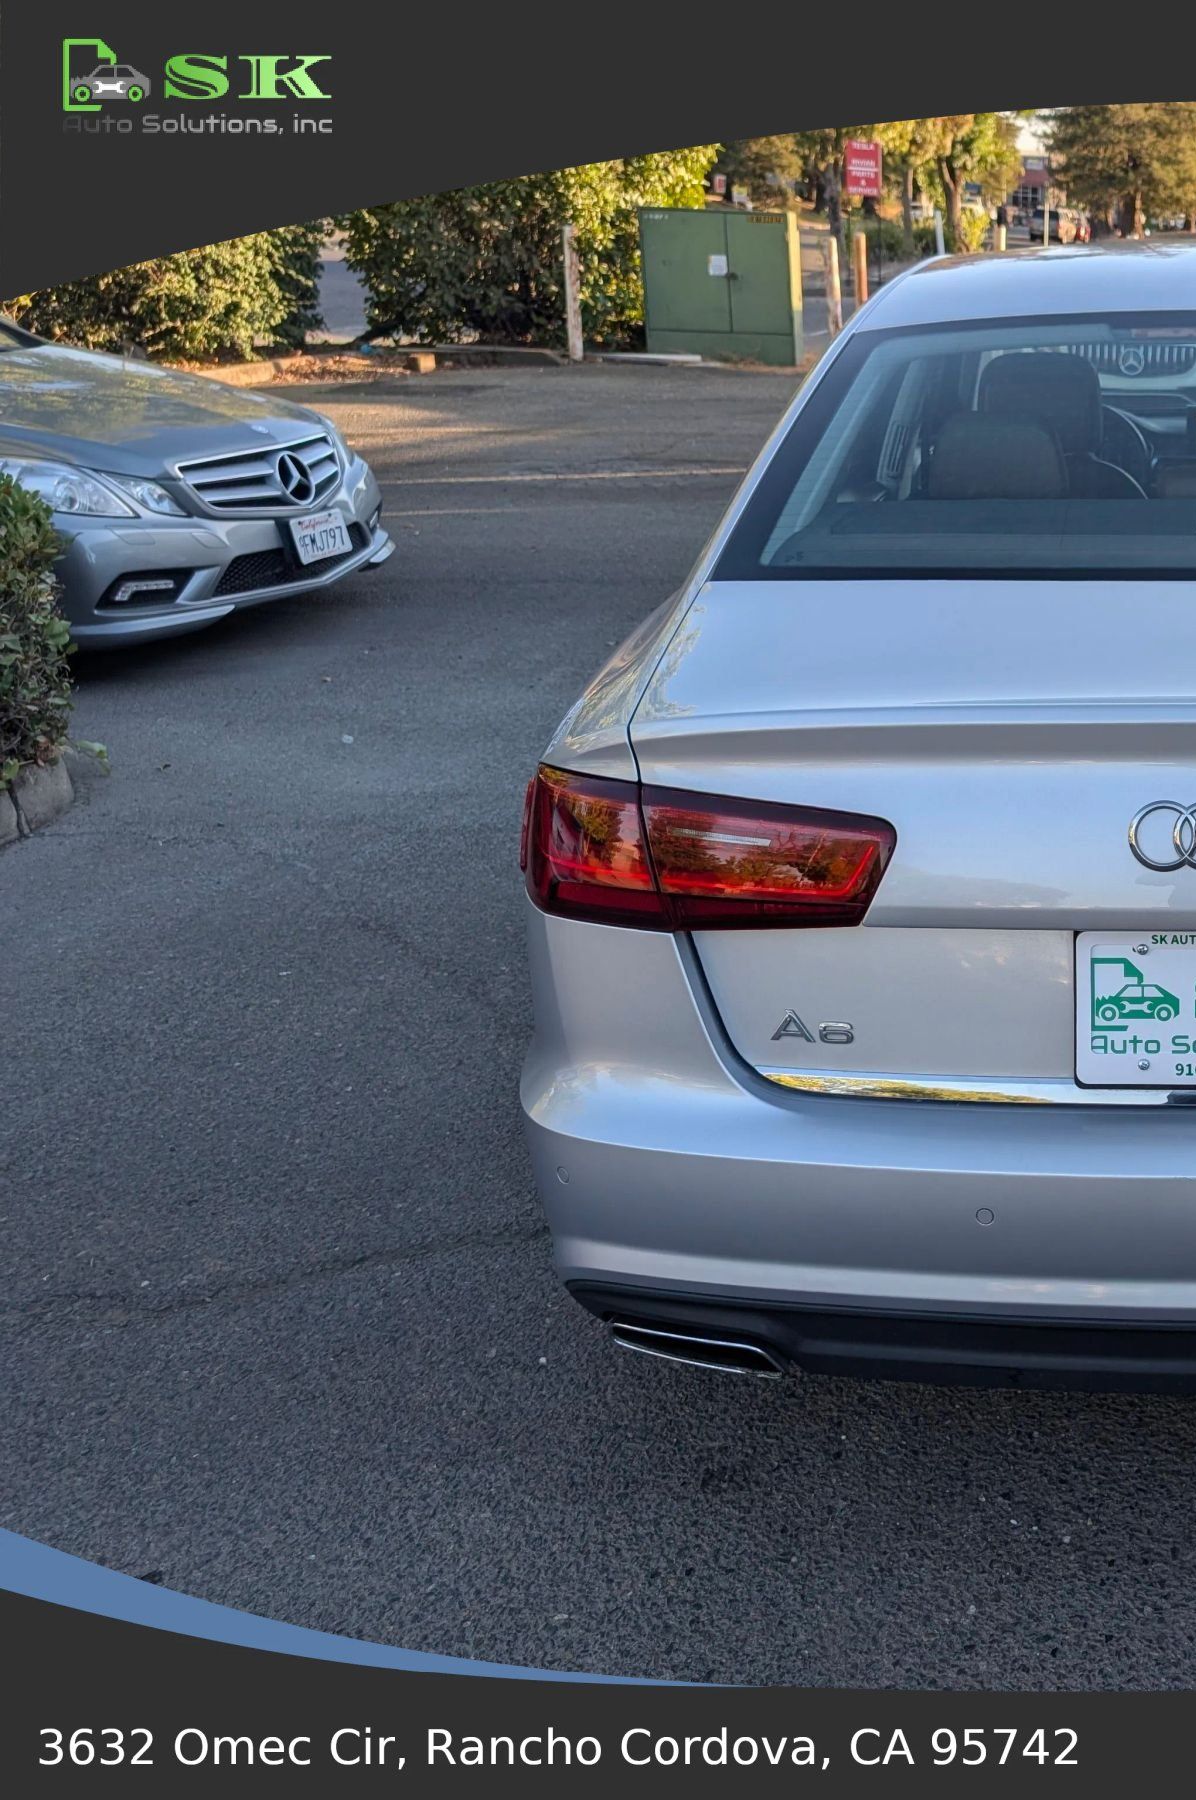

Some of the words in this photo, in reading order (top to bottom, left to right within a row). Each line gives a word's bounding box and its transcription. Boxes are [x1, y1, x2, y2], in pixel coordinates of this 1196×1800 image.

[1151, 934, 1168, 945] SK
[770, 1008, 855, 1045] A6
[1091, 1034, 1161, 1055] Auto
